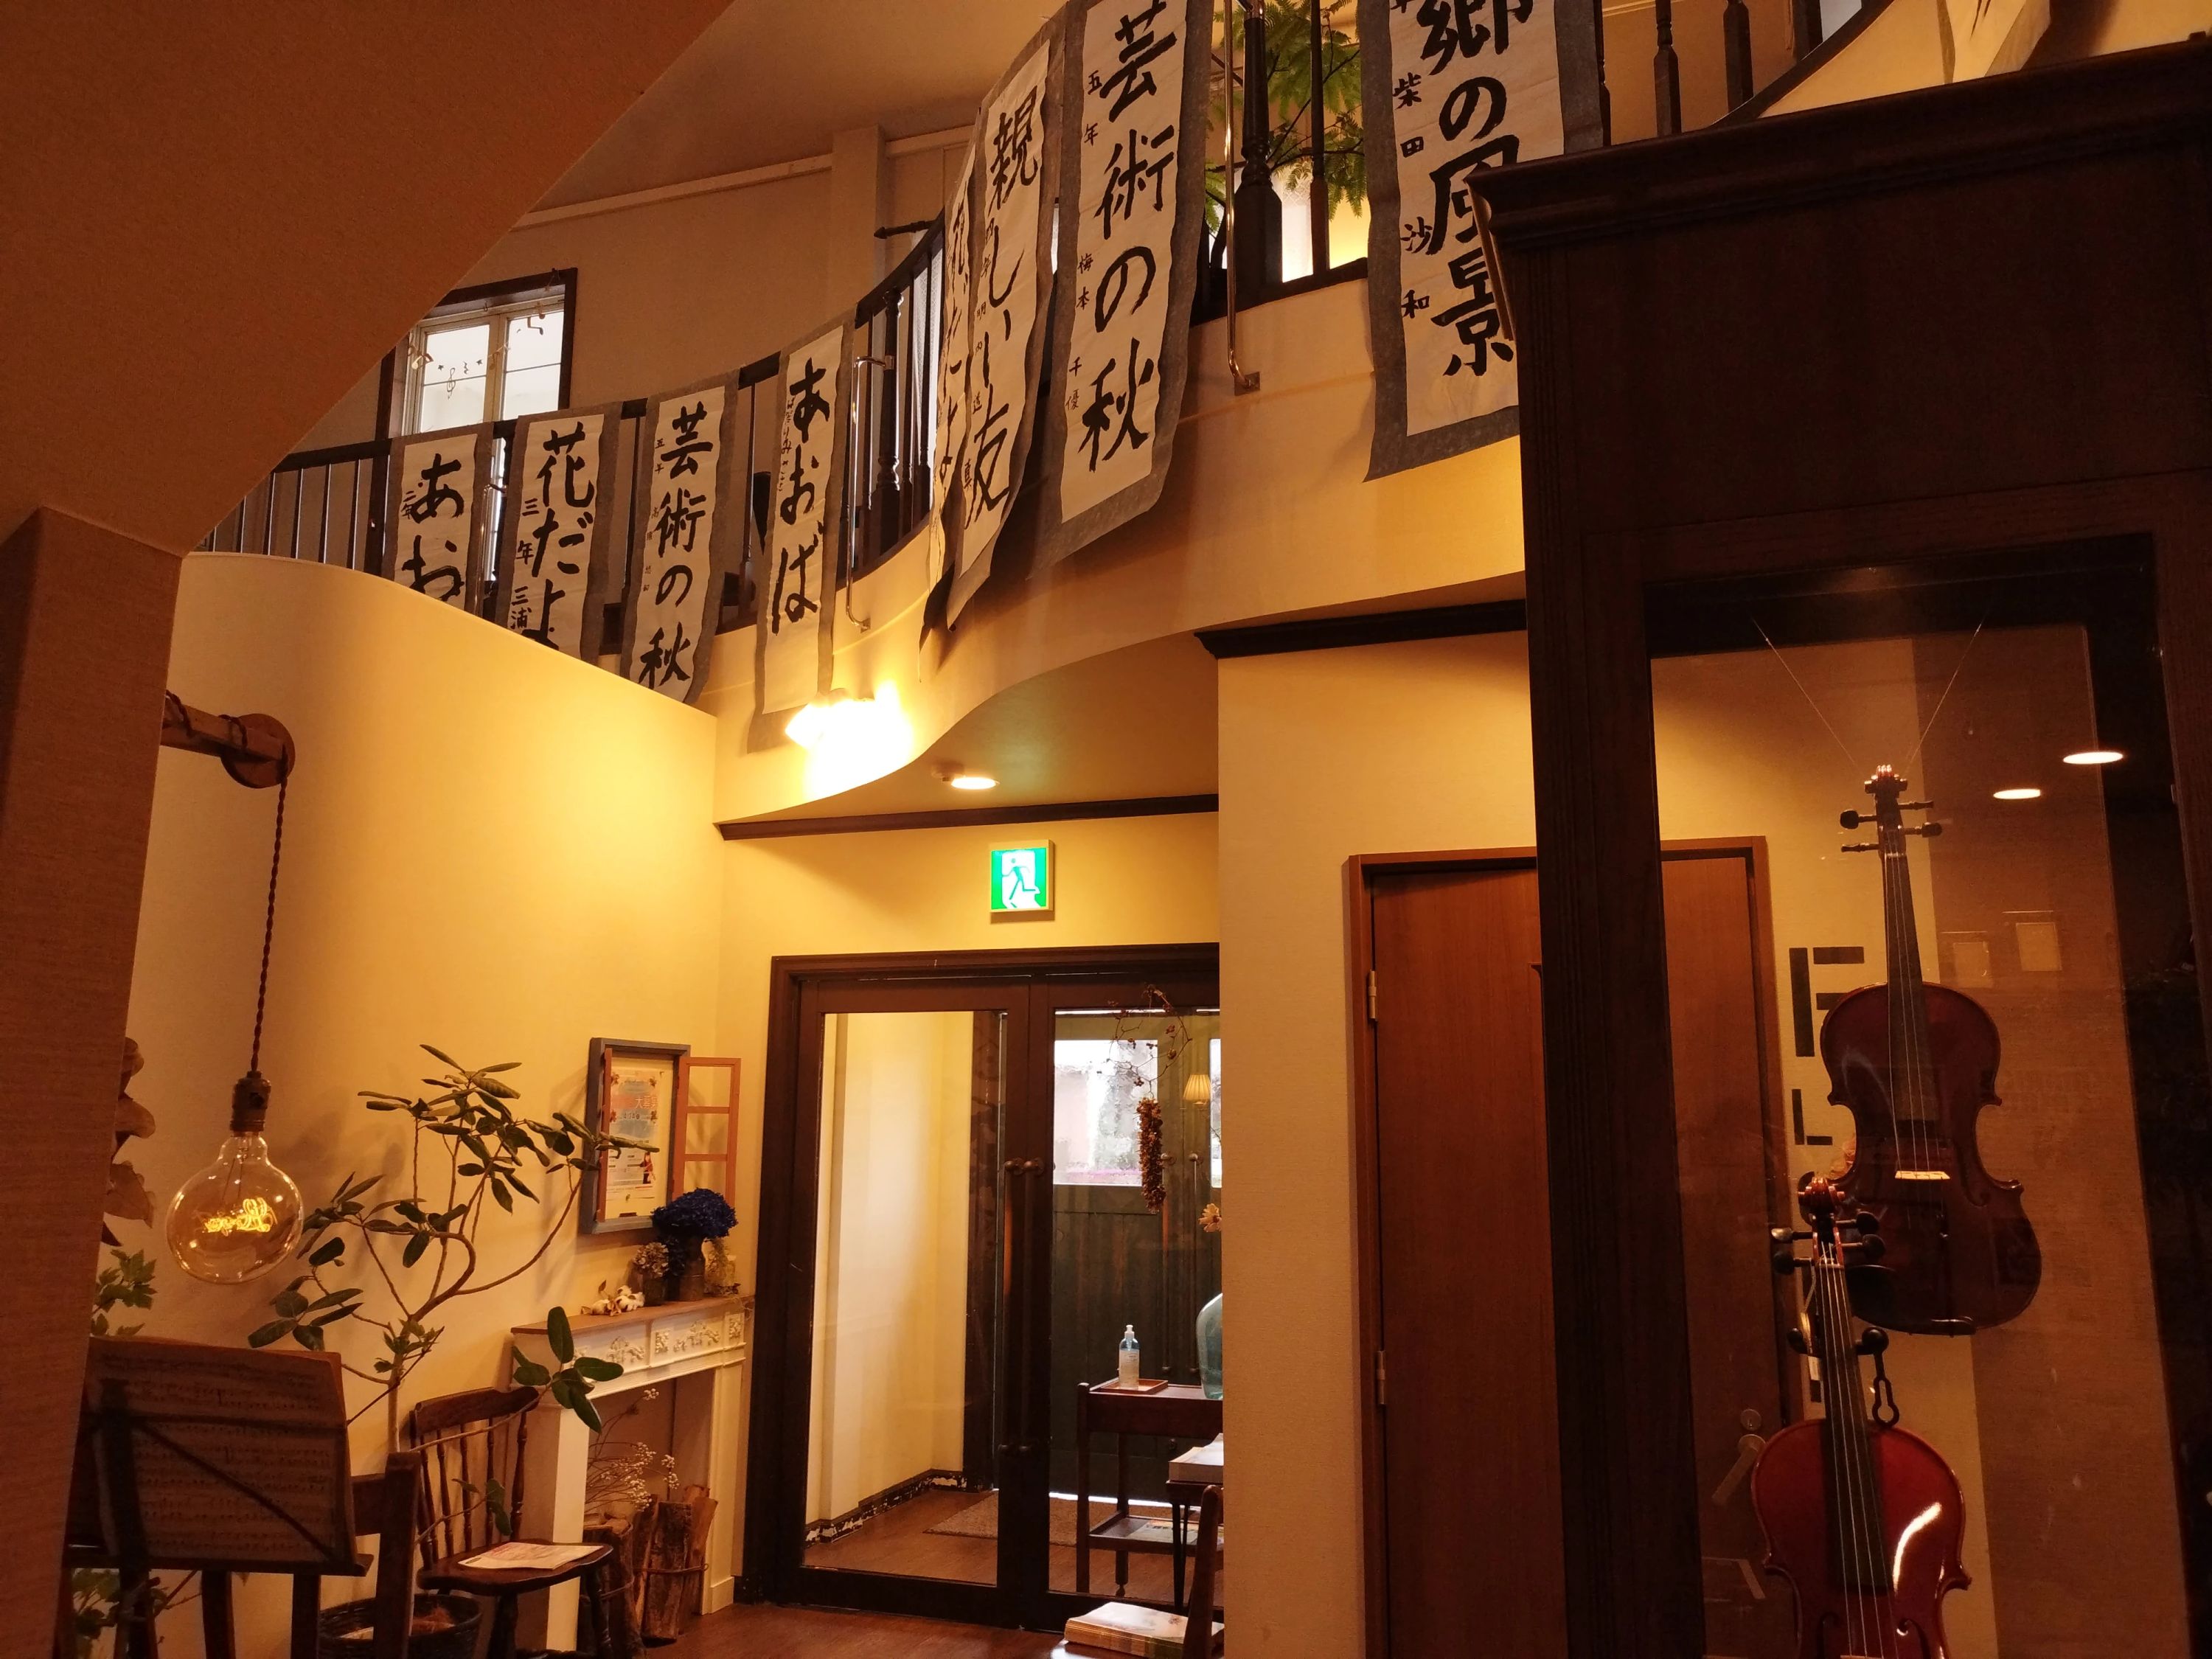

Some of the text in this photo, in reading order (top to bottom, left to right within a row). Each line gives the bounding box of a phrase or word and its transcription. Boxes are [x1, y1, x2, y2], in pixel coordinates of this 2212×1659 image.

[964, 86, 1040, 529] 親しい友
[1079, 0, 1178, 472] 芸術の秋
[639, 400, 714, 690] 芸術の秋
[772, 358, 830, 636] あおば
